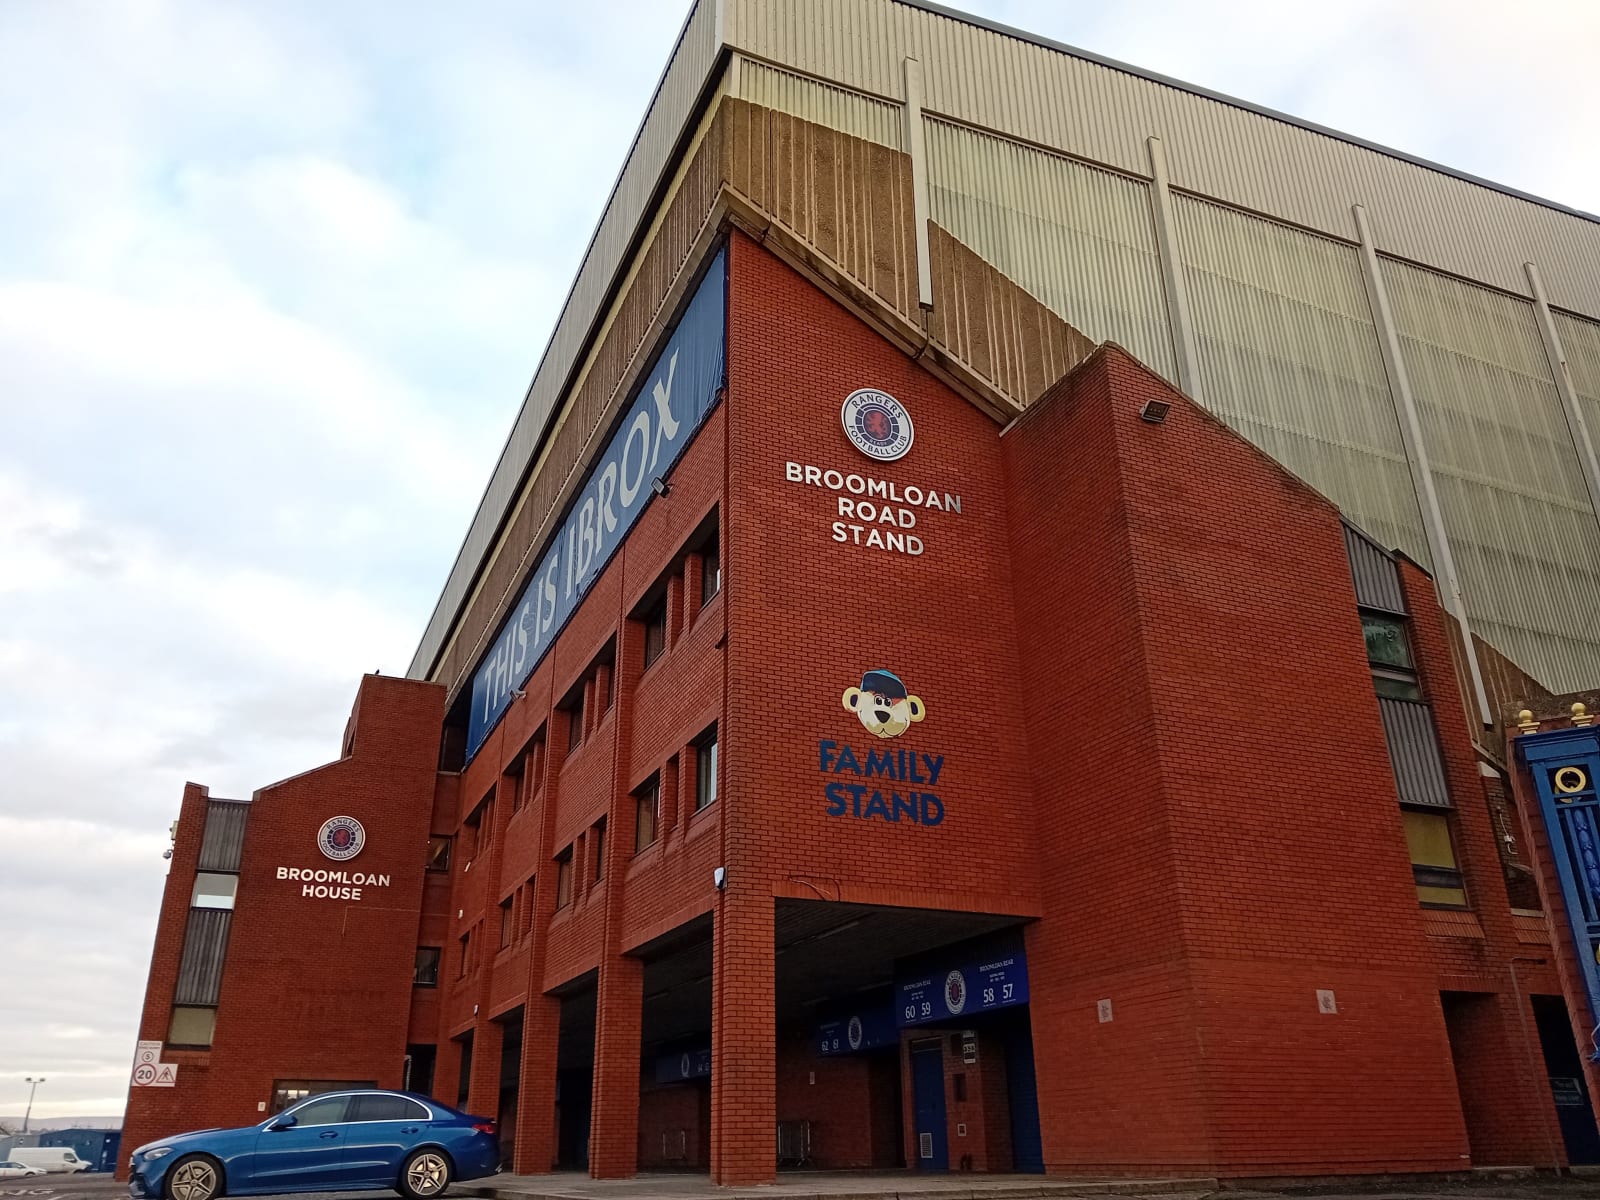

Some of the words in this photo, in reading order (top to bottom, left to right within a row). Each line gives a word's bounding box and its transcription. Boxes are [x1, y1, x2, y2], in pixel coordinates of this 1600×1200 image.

[851, 394, 904, 419] RANGERS
[848, 425, 890, 455] FOOTBALL
[891, 435, 907, 453] CLUB
[785, 461, 962, 514] BROOMLOAN
[838, 496, 916, 529] ROAD
[483, 601, 530, 724] THIS
[533, 553, 559, 649] IS
[565, 346, 681, 601] IBROX
[832, 521, 924, 555] STAND
[819, 739, 944, 785] FAMILY
[825, 782, 945, 826] STAND
[326, 819, 360, 833] RANGERS
[276, 866, 391, 887] BROOMLOAN
[302, 885, 362, 900] HOUSE
[983, 988, 994, 1003] 58
[1002, 983, 1013, 999] 57
[905, 1005, 916, 1019] 60
[921, 1001, 931, 1016] 59
[137, 1069, 152, 1080] 20
